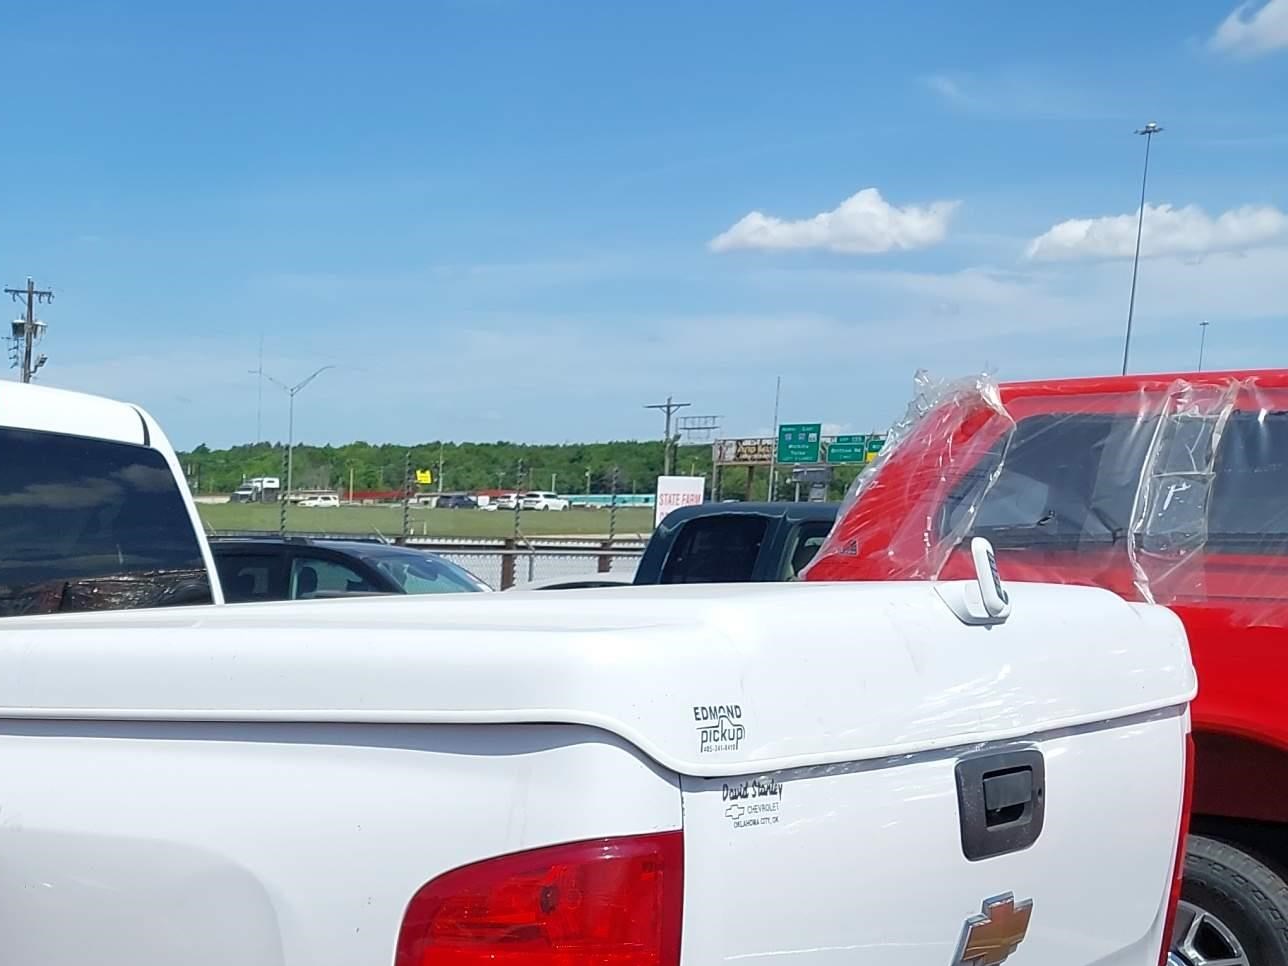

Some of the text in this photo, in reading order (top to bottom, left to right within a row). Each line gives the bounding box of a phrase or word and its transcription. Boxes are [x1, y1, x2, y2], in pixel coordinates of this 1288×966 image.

[659, 493, 680, 505] STATE
[693, 705, 742, 721] EDMOND
[722, 778, 783, 801] David Stanley
[747, 802, 779, 814] CHEVROLET
[733, 818, 759, 828] OKLAHOMA
